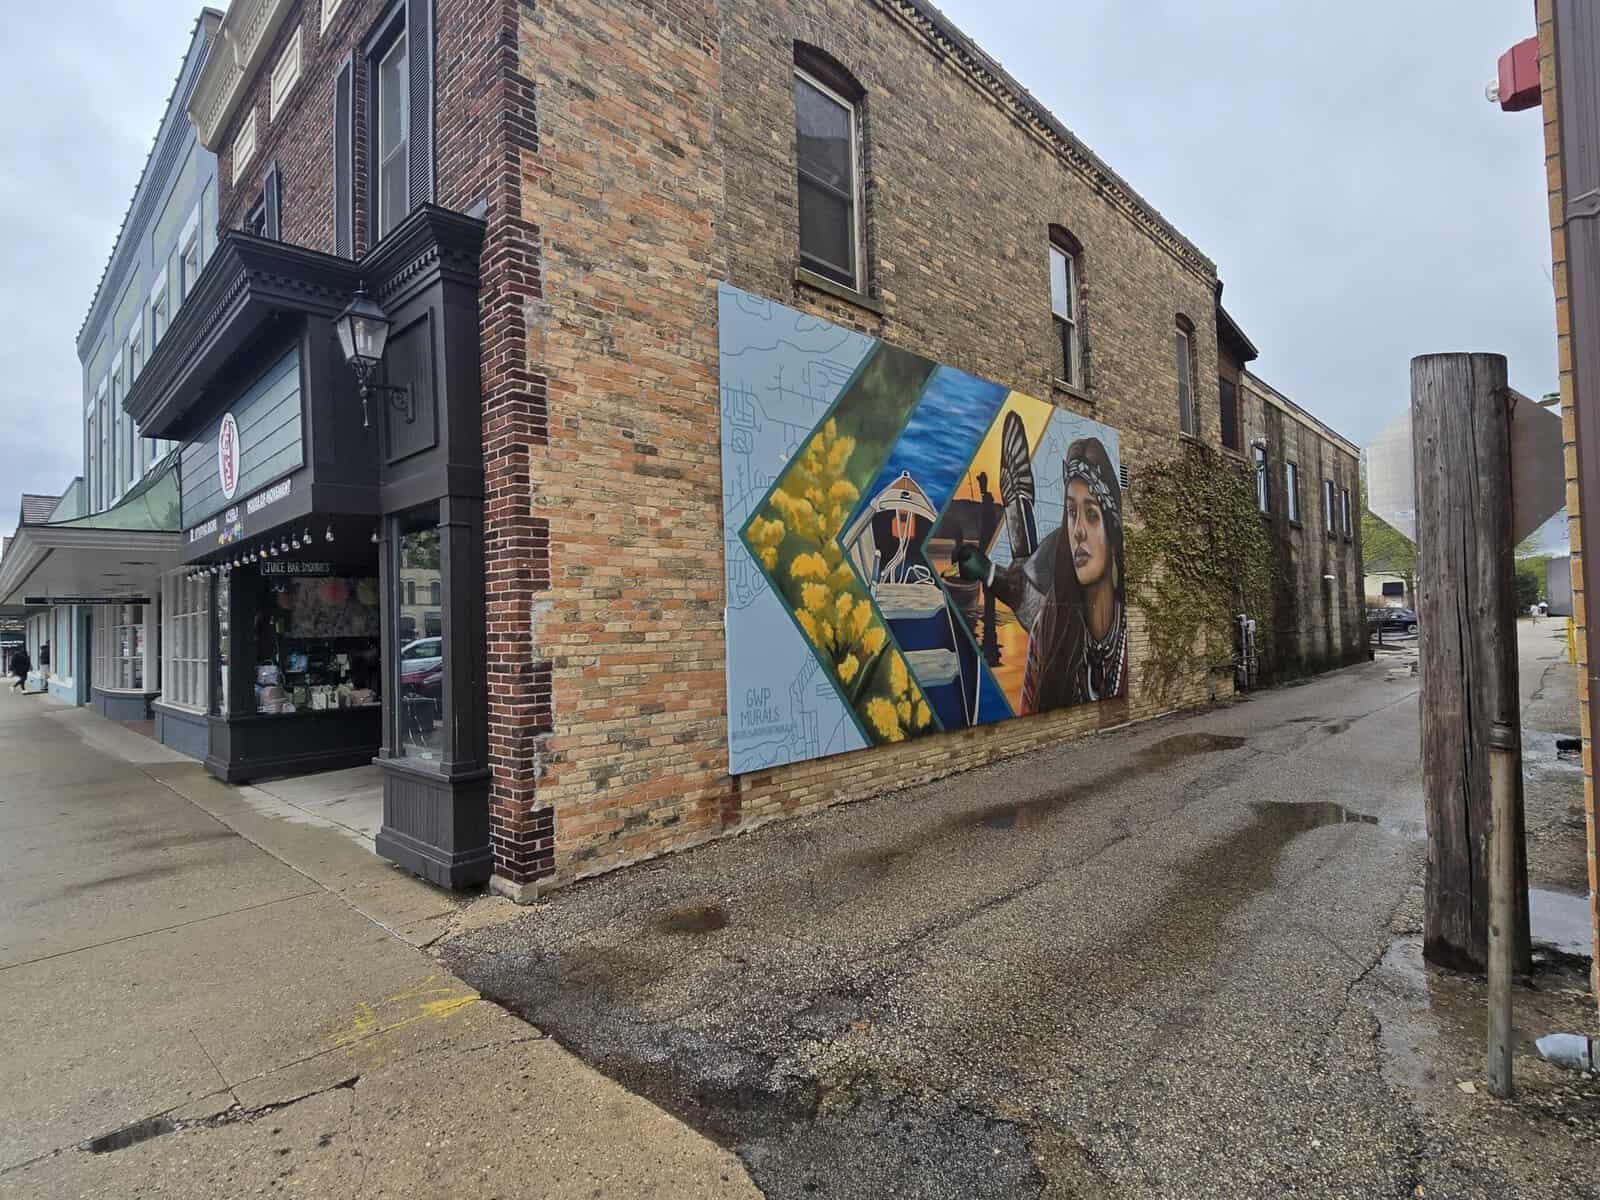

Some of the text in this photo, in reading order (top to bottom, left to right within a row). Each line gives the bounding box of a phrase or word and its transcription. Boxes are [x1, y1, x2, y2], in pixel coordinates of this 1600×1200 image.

[265, 562, 285, 573] JUICE
[746, 688, 771, 707] GWP
[740, 706, 780, 728] MURALS
